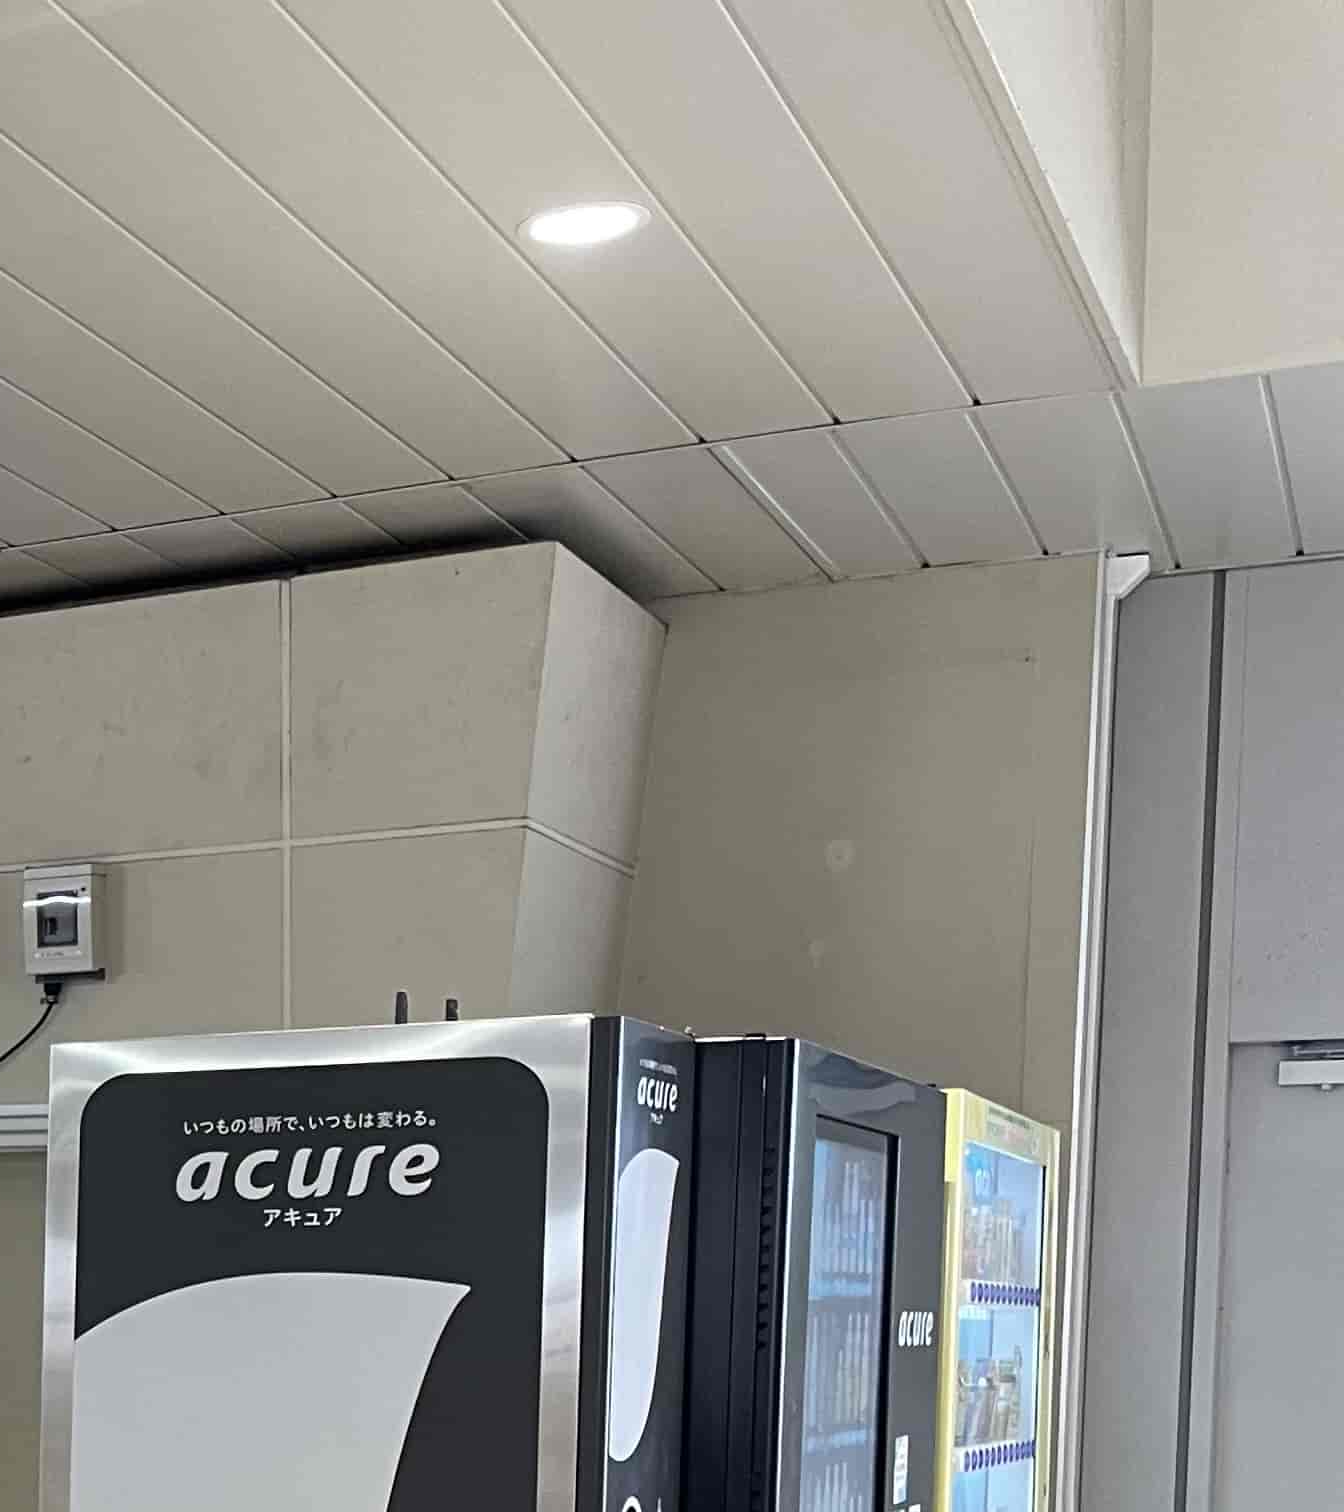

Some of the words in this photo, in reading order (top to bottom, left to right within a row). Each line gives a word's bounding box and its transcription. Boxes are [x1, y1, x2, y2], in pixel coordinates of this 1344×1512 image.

[637, 1076, 678, 1112] acure
[183, 1110, 436, 1136] いつもの場所で、いつもは変わる。
[175, 1143, 440, 1202] acure
[263, 1207, 342, 1227] アキュア
[898, 1311, 934, 1346] acure
